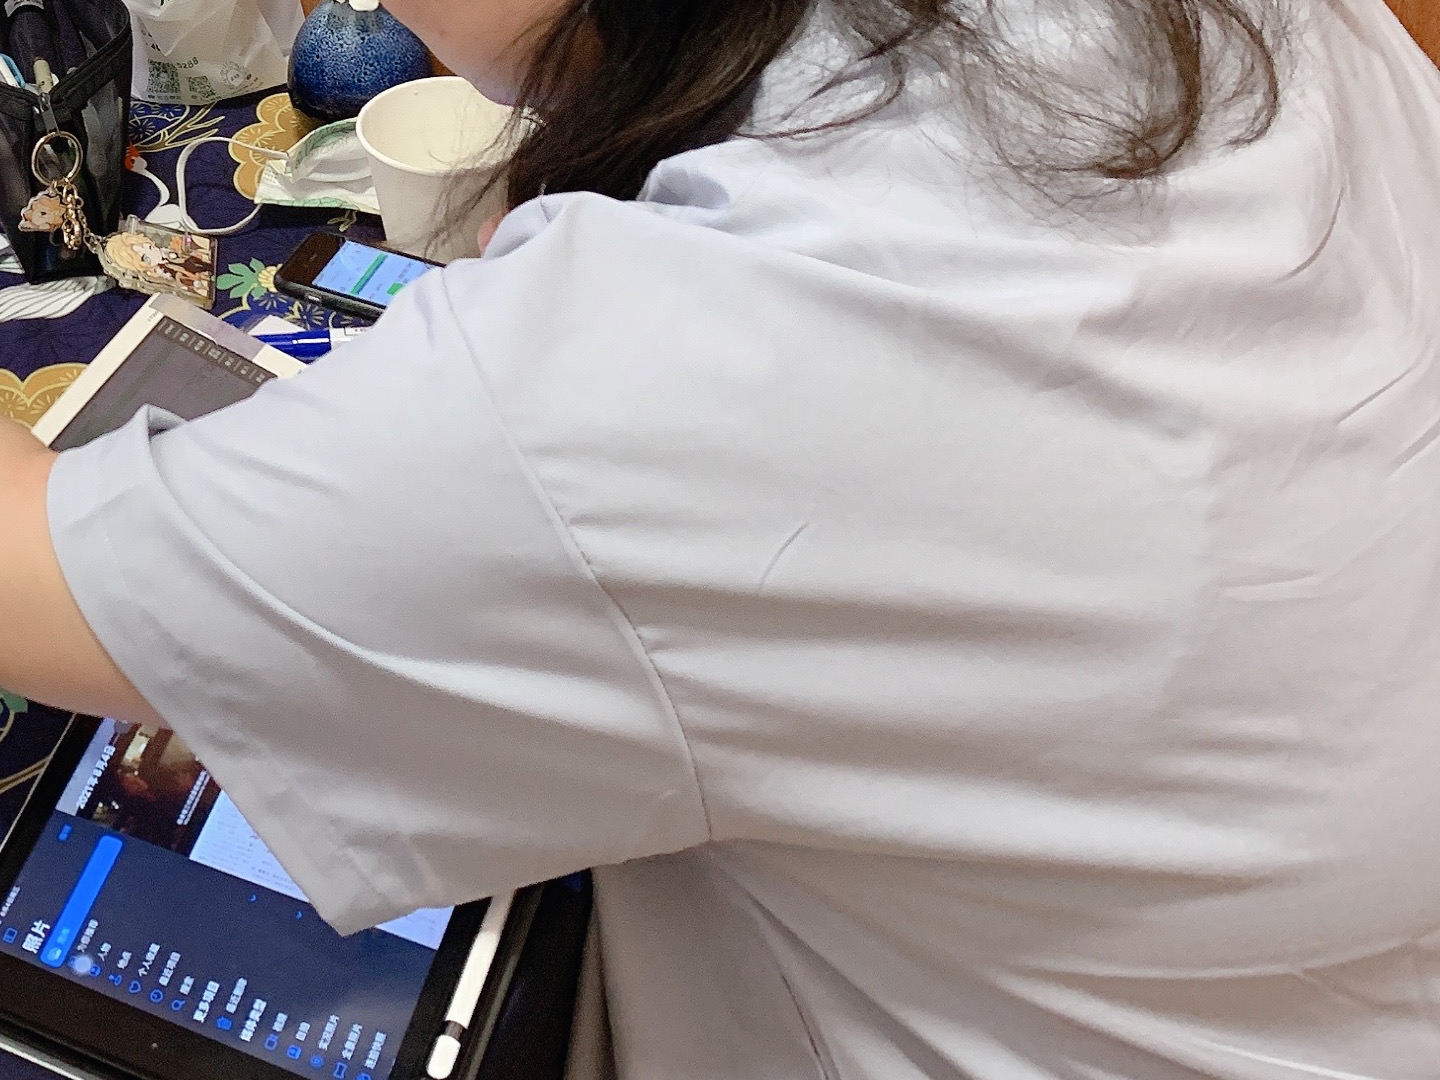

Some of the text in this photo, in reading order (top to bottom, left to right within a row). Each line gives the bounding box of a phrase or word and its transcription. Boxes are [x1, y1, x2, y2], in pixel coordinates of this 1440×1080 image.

[22, 920, 50, 953] 照片
[193, 981, 219, 1023] 更多项目
